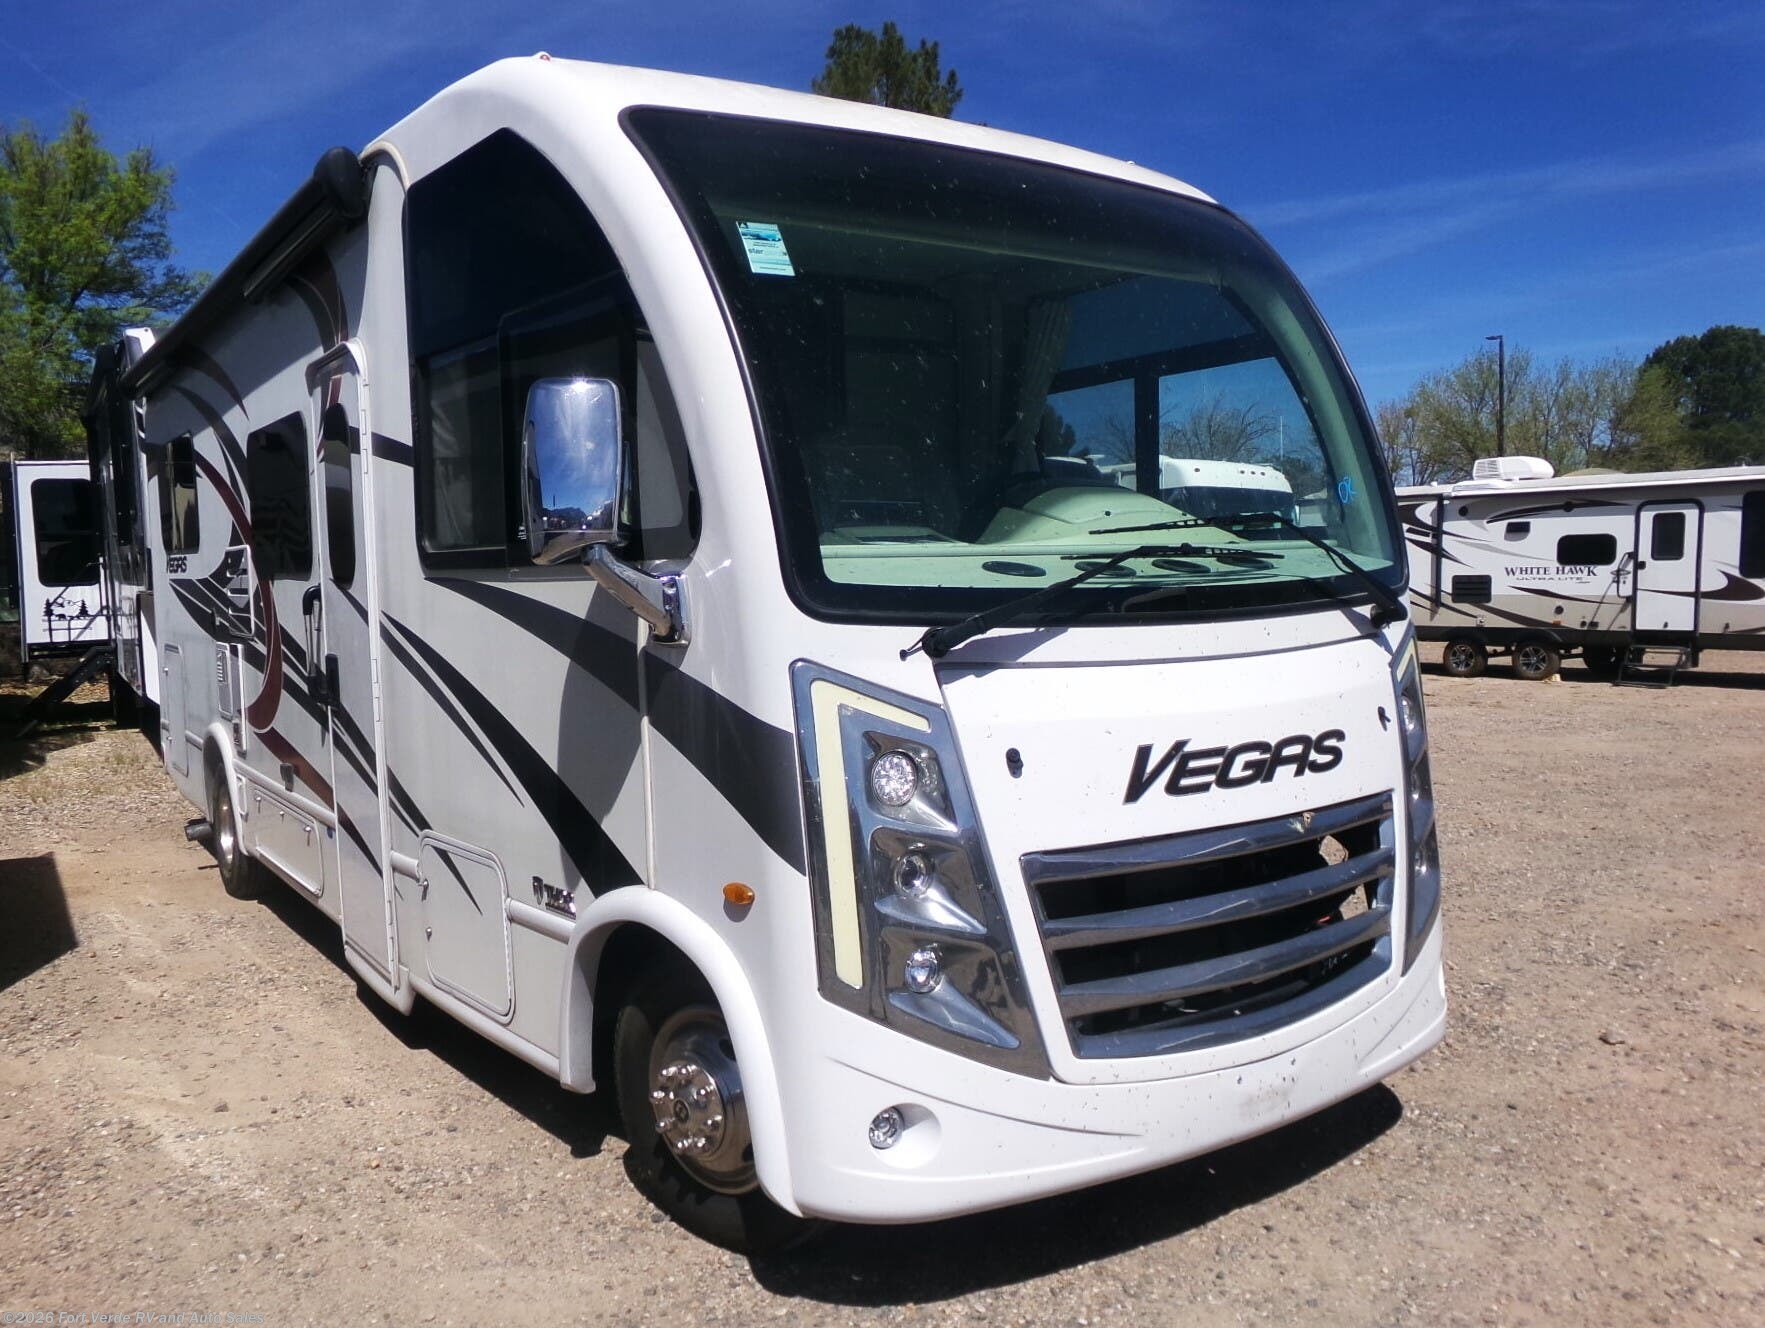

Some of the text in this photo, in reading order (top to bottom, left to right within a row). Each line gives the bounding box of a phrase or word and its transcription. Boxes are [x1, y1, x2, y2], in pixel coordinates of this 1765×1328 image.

[1504, 566, 1598, 577] WHITE HAWK
[1122, 729, 1346, 805] VEGAS
